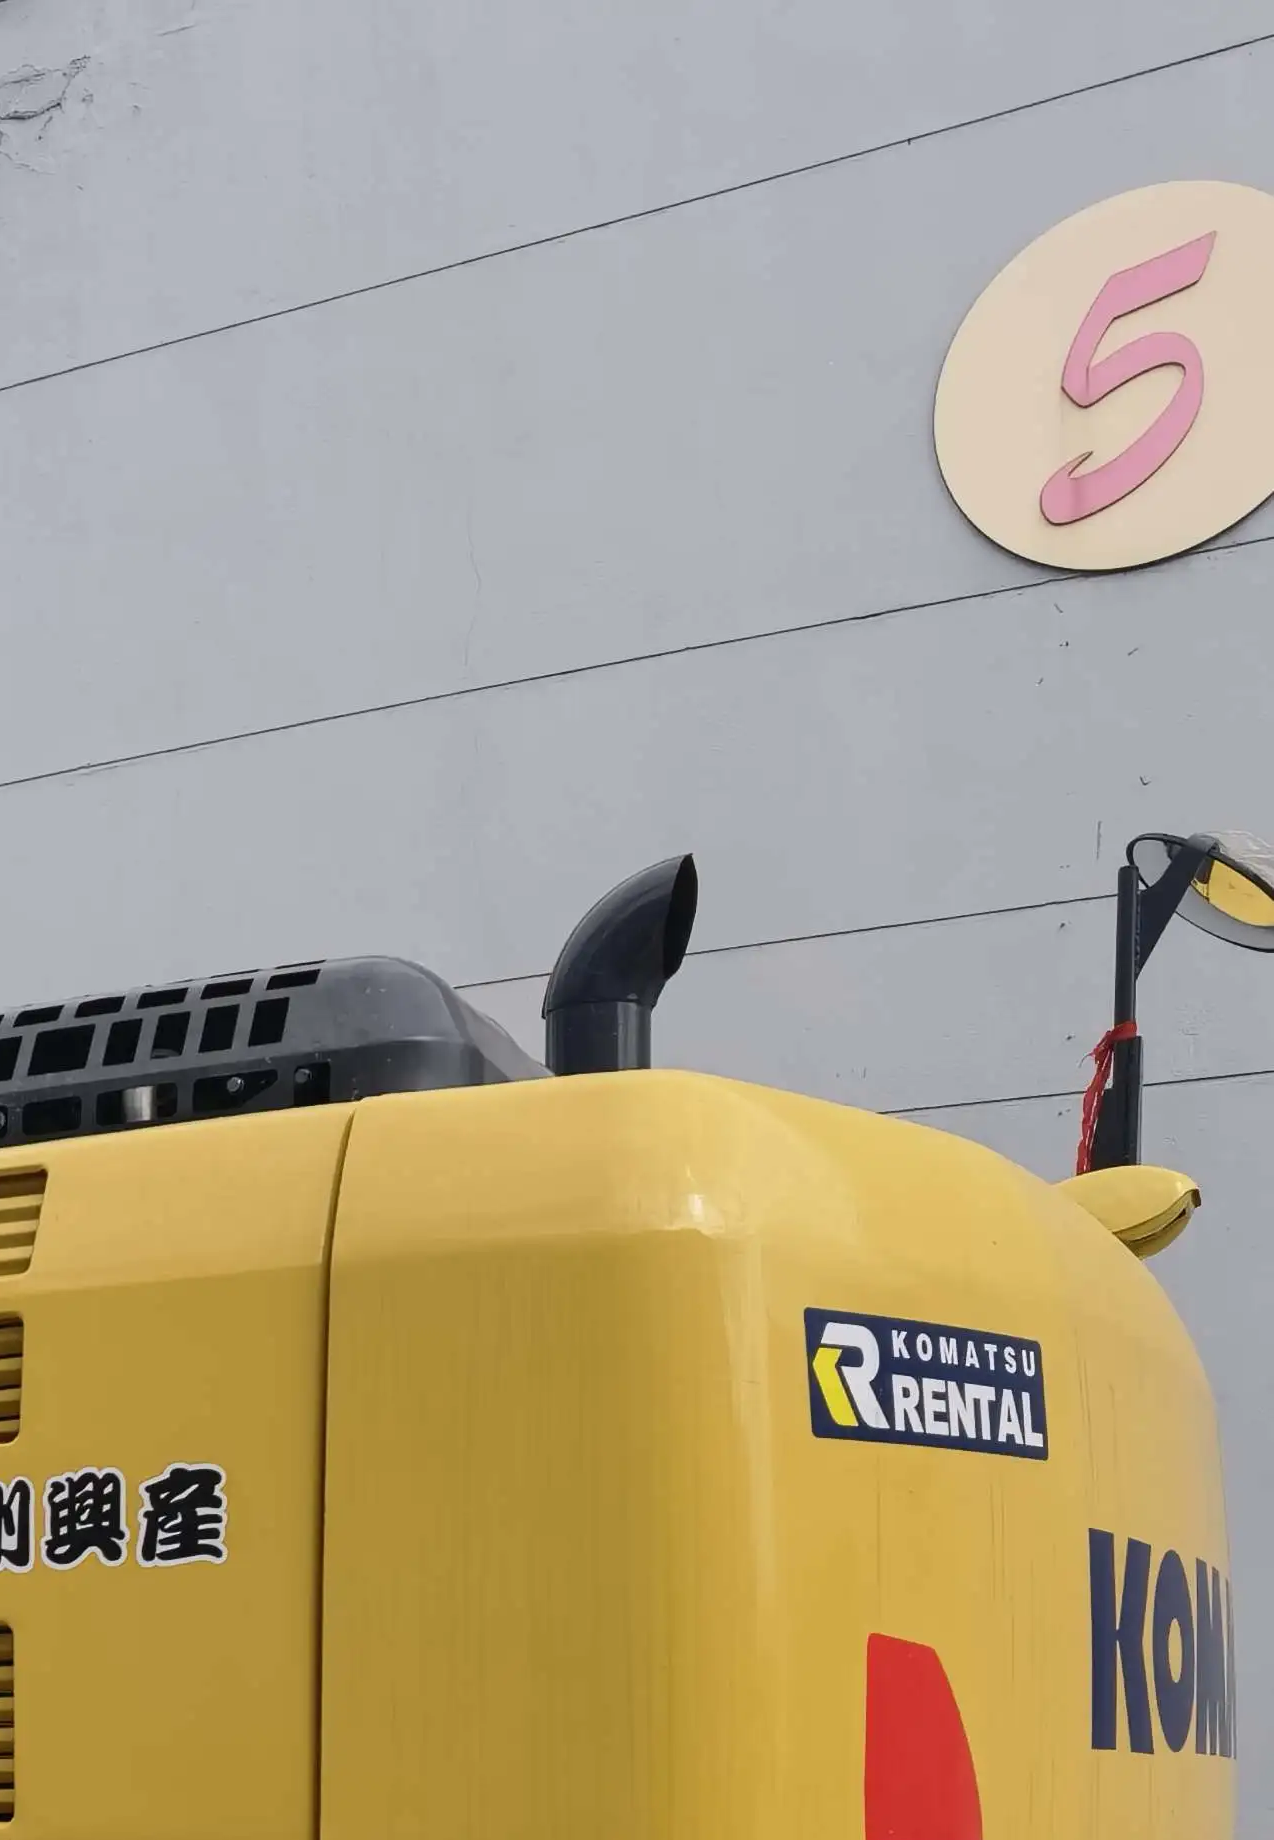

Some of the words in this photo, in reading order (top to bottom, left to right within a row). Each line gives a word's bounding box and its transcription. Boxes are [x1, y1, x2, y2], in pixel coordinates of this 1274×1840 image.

[1040, 231, 1217, 525] 5
[891, 1330, 1035, 1377] KOMATSU
[892, 1374, 1044, 1448] RENTAL
